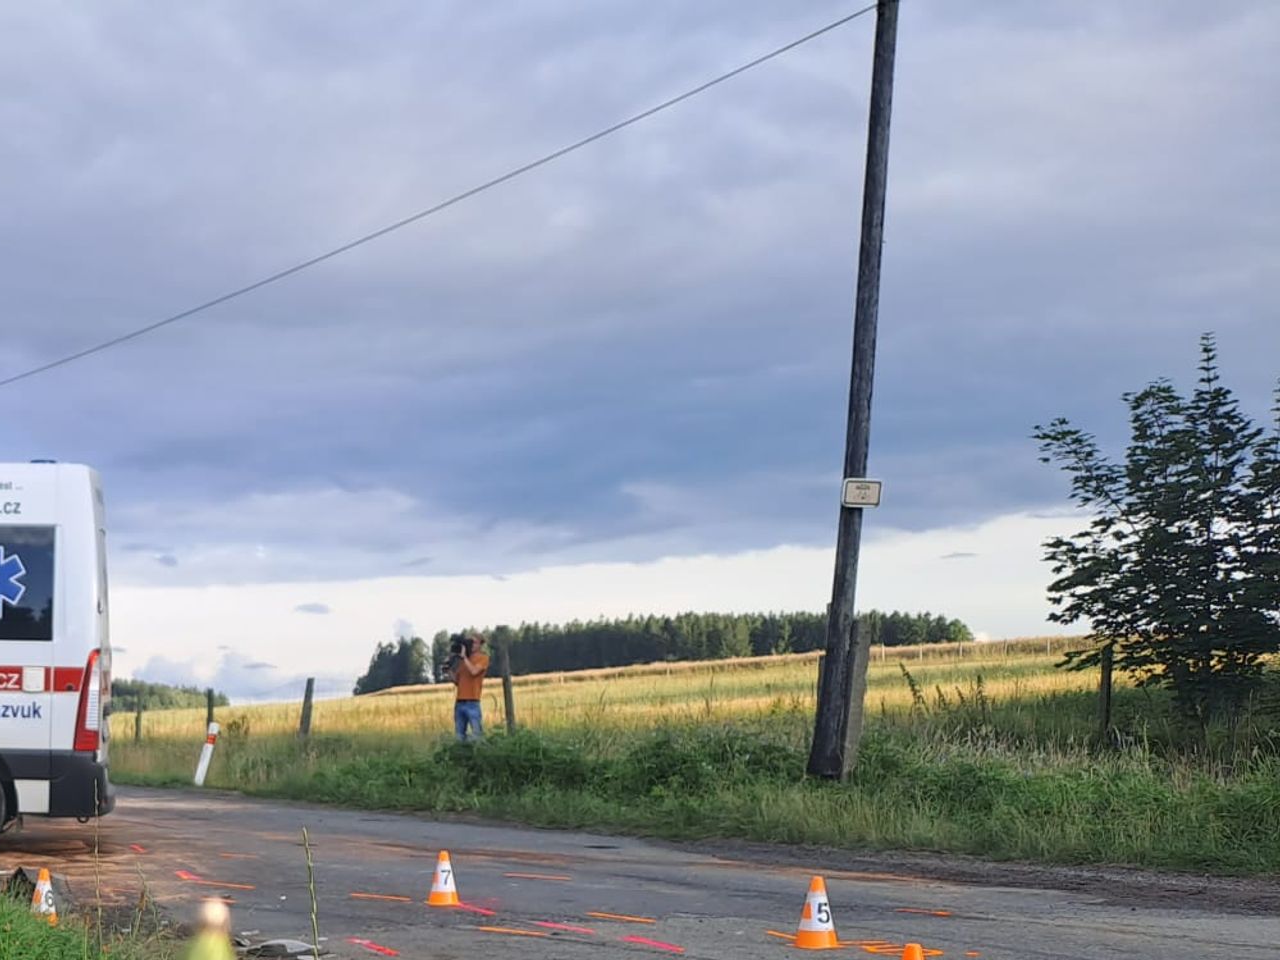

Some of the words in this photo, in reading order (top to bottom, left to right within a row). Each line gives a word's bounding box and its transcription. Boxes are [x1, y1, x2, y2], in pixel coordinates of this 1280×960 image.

[440, 869, 451, 886] 7
[45, 890, 54, 908] 6
[817, 902, 830, 923] 5
